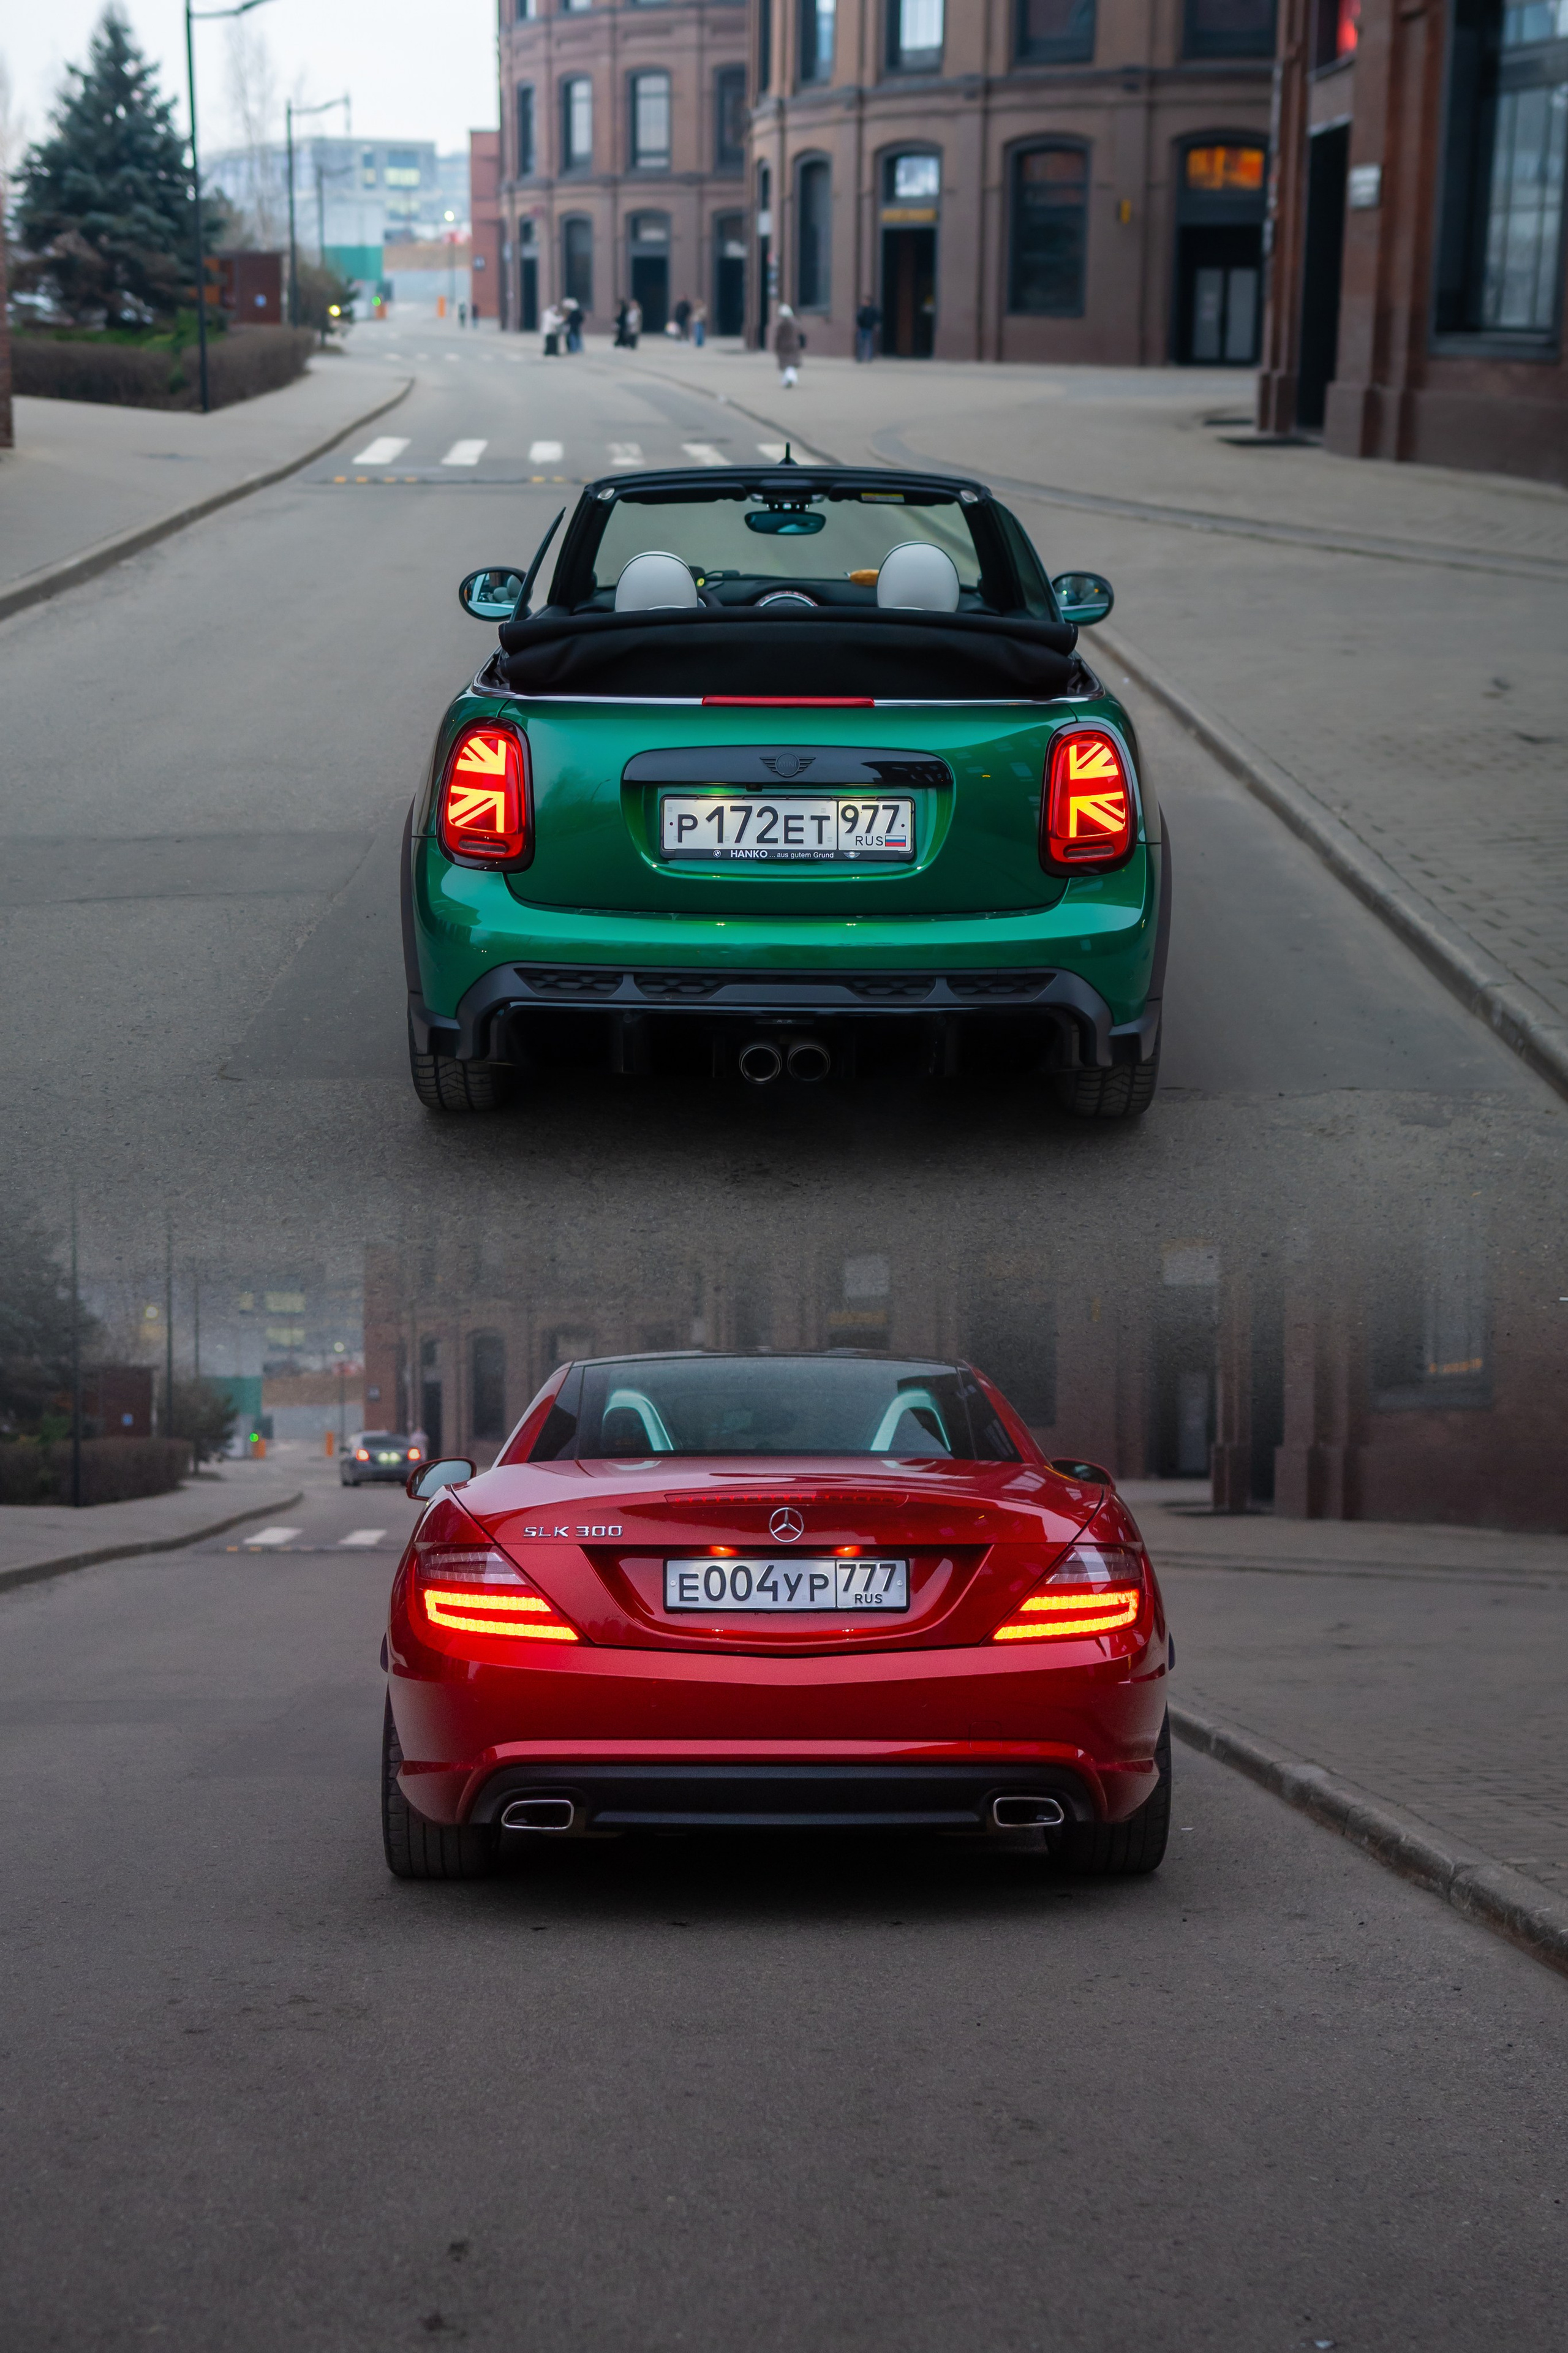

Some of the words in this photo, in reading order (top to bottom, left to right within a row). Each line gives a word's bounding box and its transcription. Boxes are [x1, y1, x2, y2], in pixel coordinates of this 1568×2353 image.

[841, 804, 899, 834] 977
[855, 836, 883, 846] RUS
[523, 1526, 569, 1537] SLK
[575, 1525, 623, 1537] 300
[839, 1563, 896, 1592] 777
[854, 1593, 883, 1604] RUS
